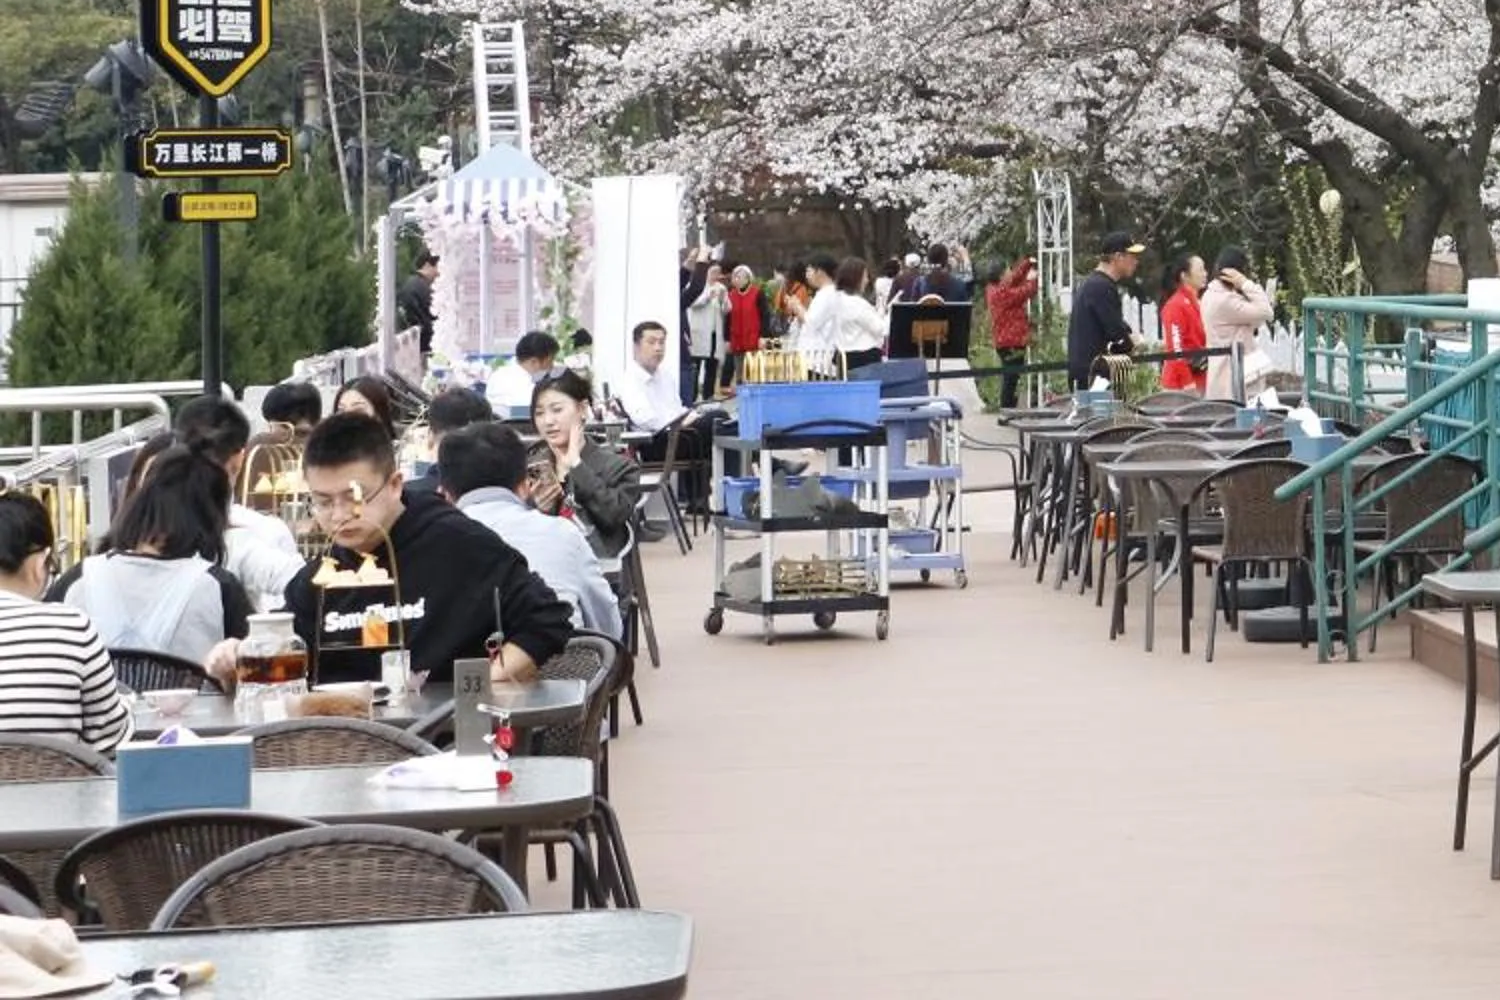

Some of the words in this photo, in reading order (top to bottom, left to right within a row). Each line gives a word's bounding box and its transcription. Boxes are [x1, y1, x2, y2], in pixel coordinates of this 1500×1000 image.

[177, 9, 253, 43] 必驾
[154, 142, 278, 163] 万里长江第一桥
